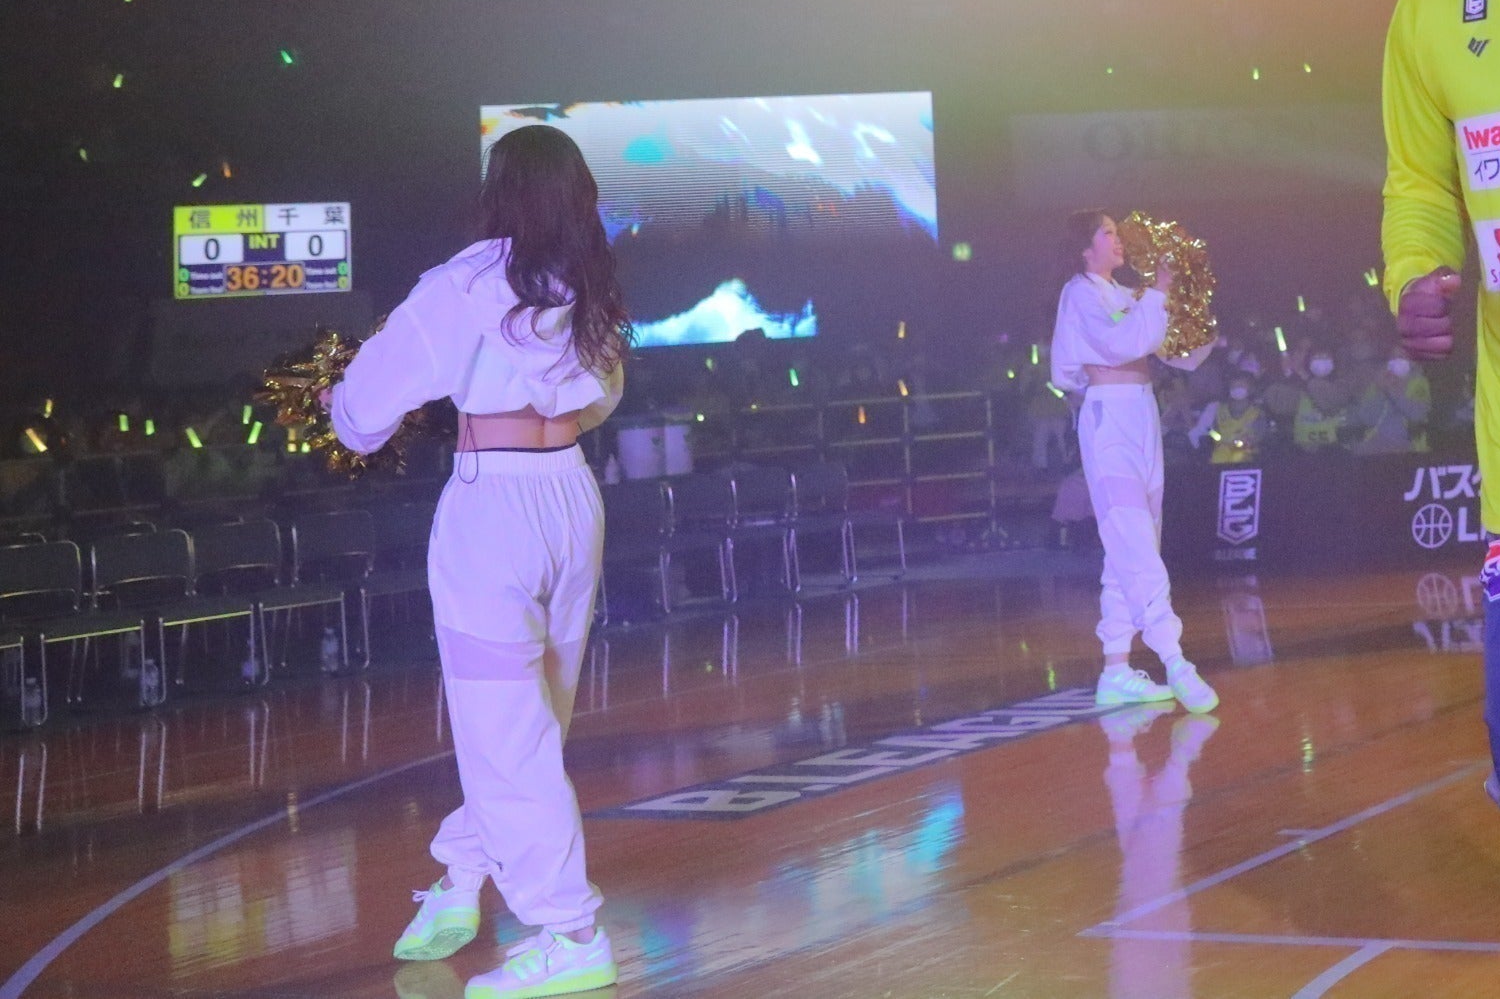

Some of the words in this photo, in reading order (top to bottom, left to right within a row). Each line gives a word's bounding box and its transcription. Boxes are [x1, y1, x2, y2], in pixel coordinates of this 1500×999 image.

[188, 208, 259, 229] 信州
[278, 206, 345, 226] 千葉
[204, 238, 220, 260] 0
[249, 234, 280, 249] INT
[308, 235, 323, 256] 0
[226, 264, 303, 291] 36:20
